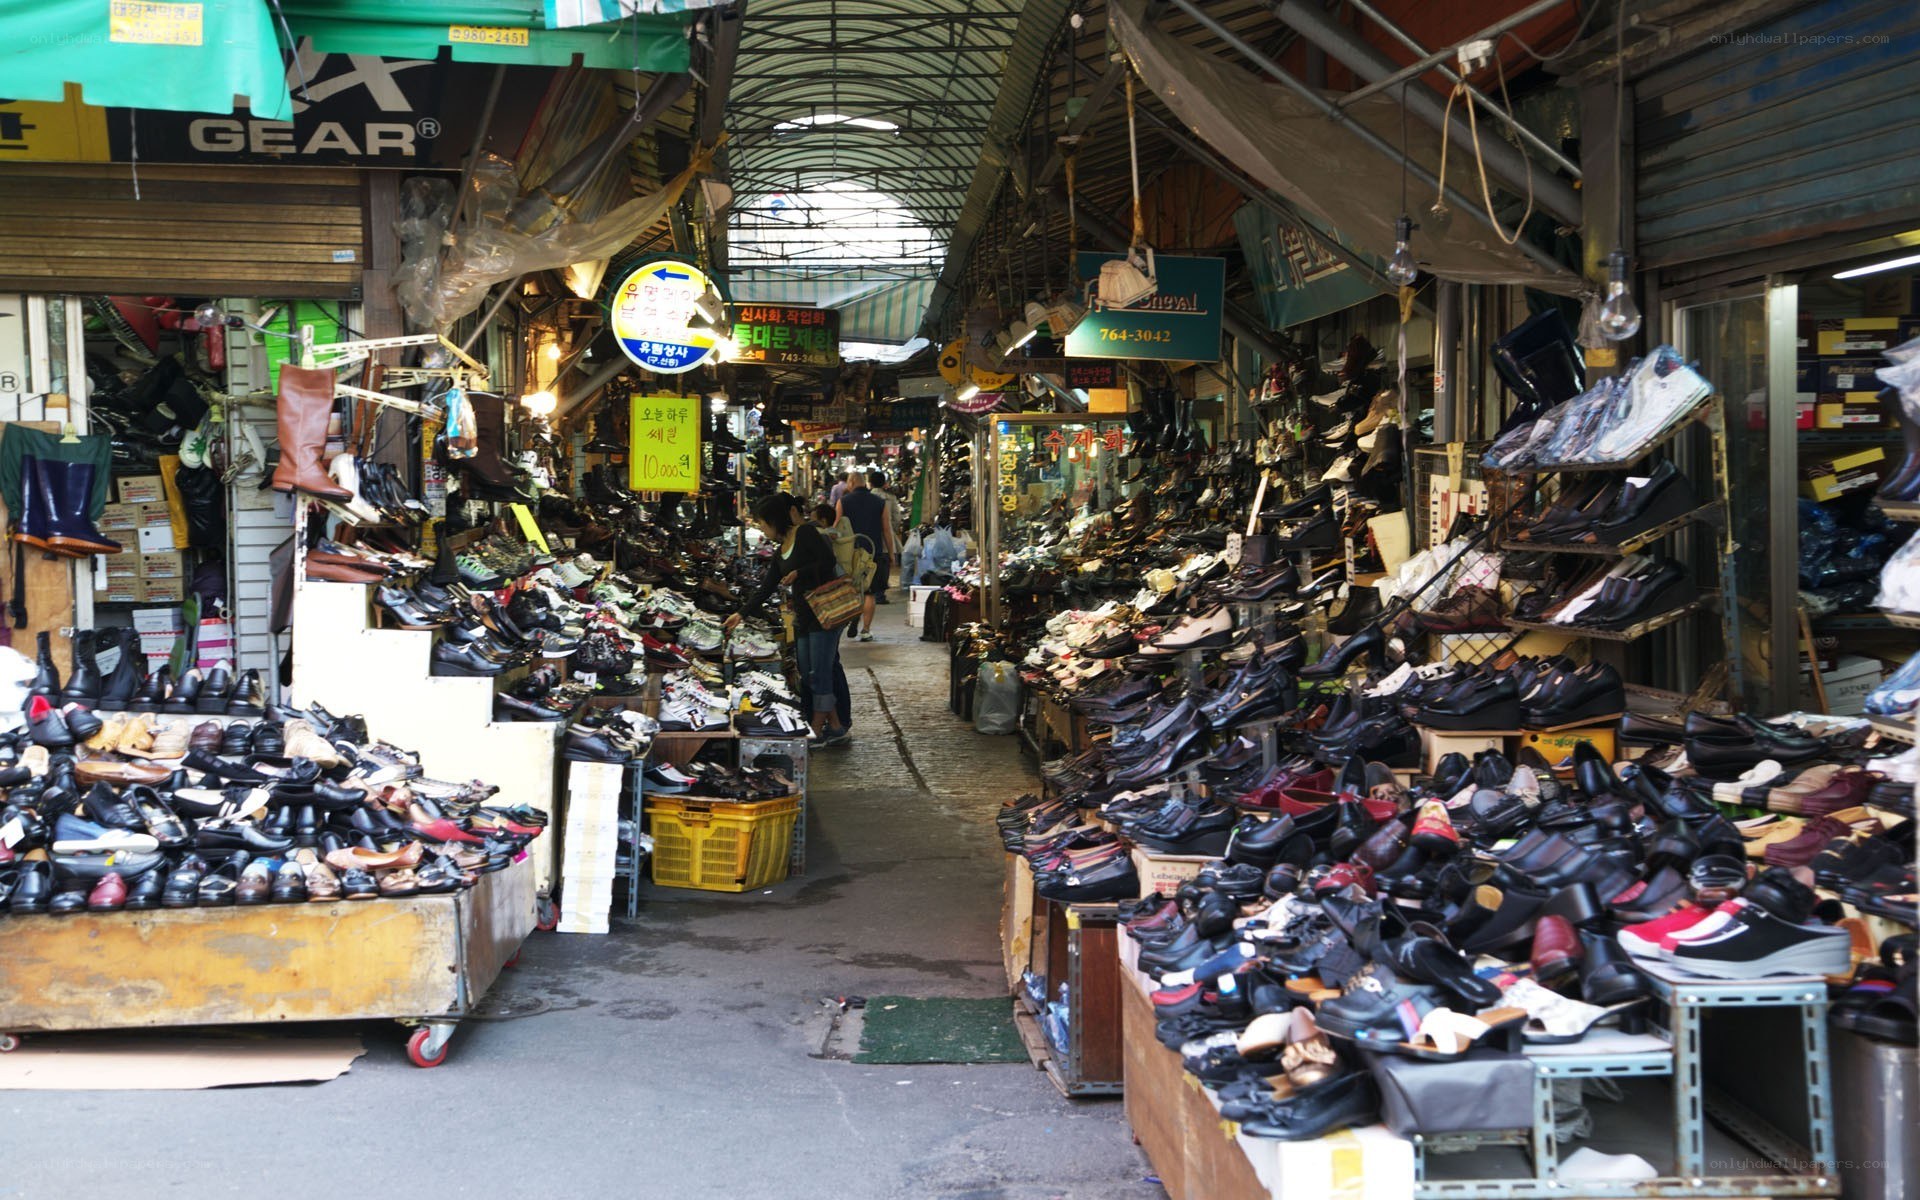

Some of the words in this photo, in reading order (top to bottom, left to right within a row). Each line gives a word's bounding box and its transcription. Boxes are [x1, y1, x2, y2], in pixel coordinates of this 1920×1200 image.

[463, 29, 525, 44] 980-2451
[189, 118, 416, 156] GEAR
[1100, 328, 1171, 343] 764-3042
